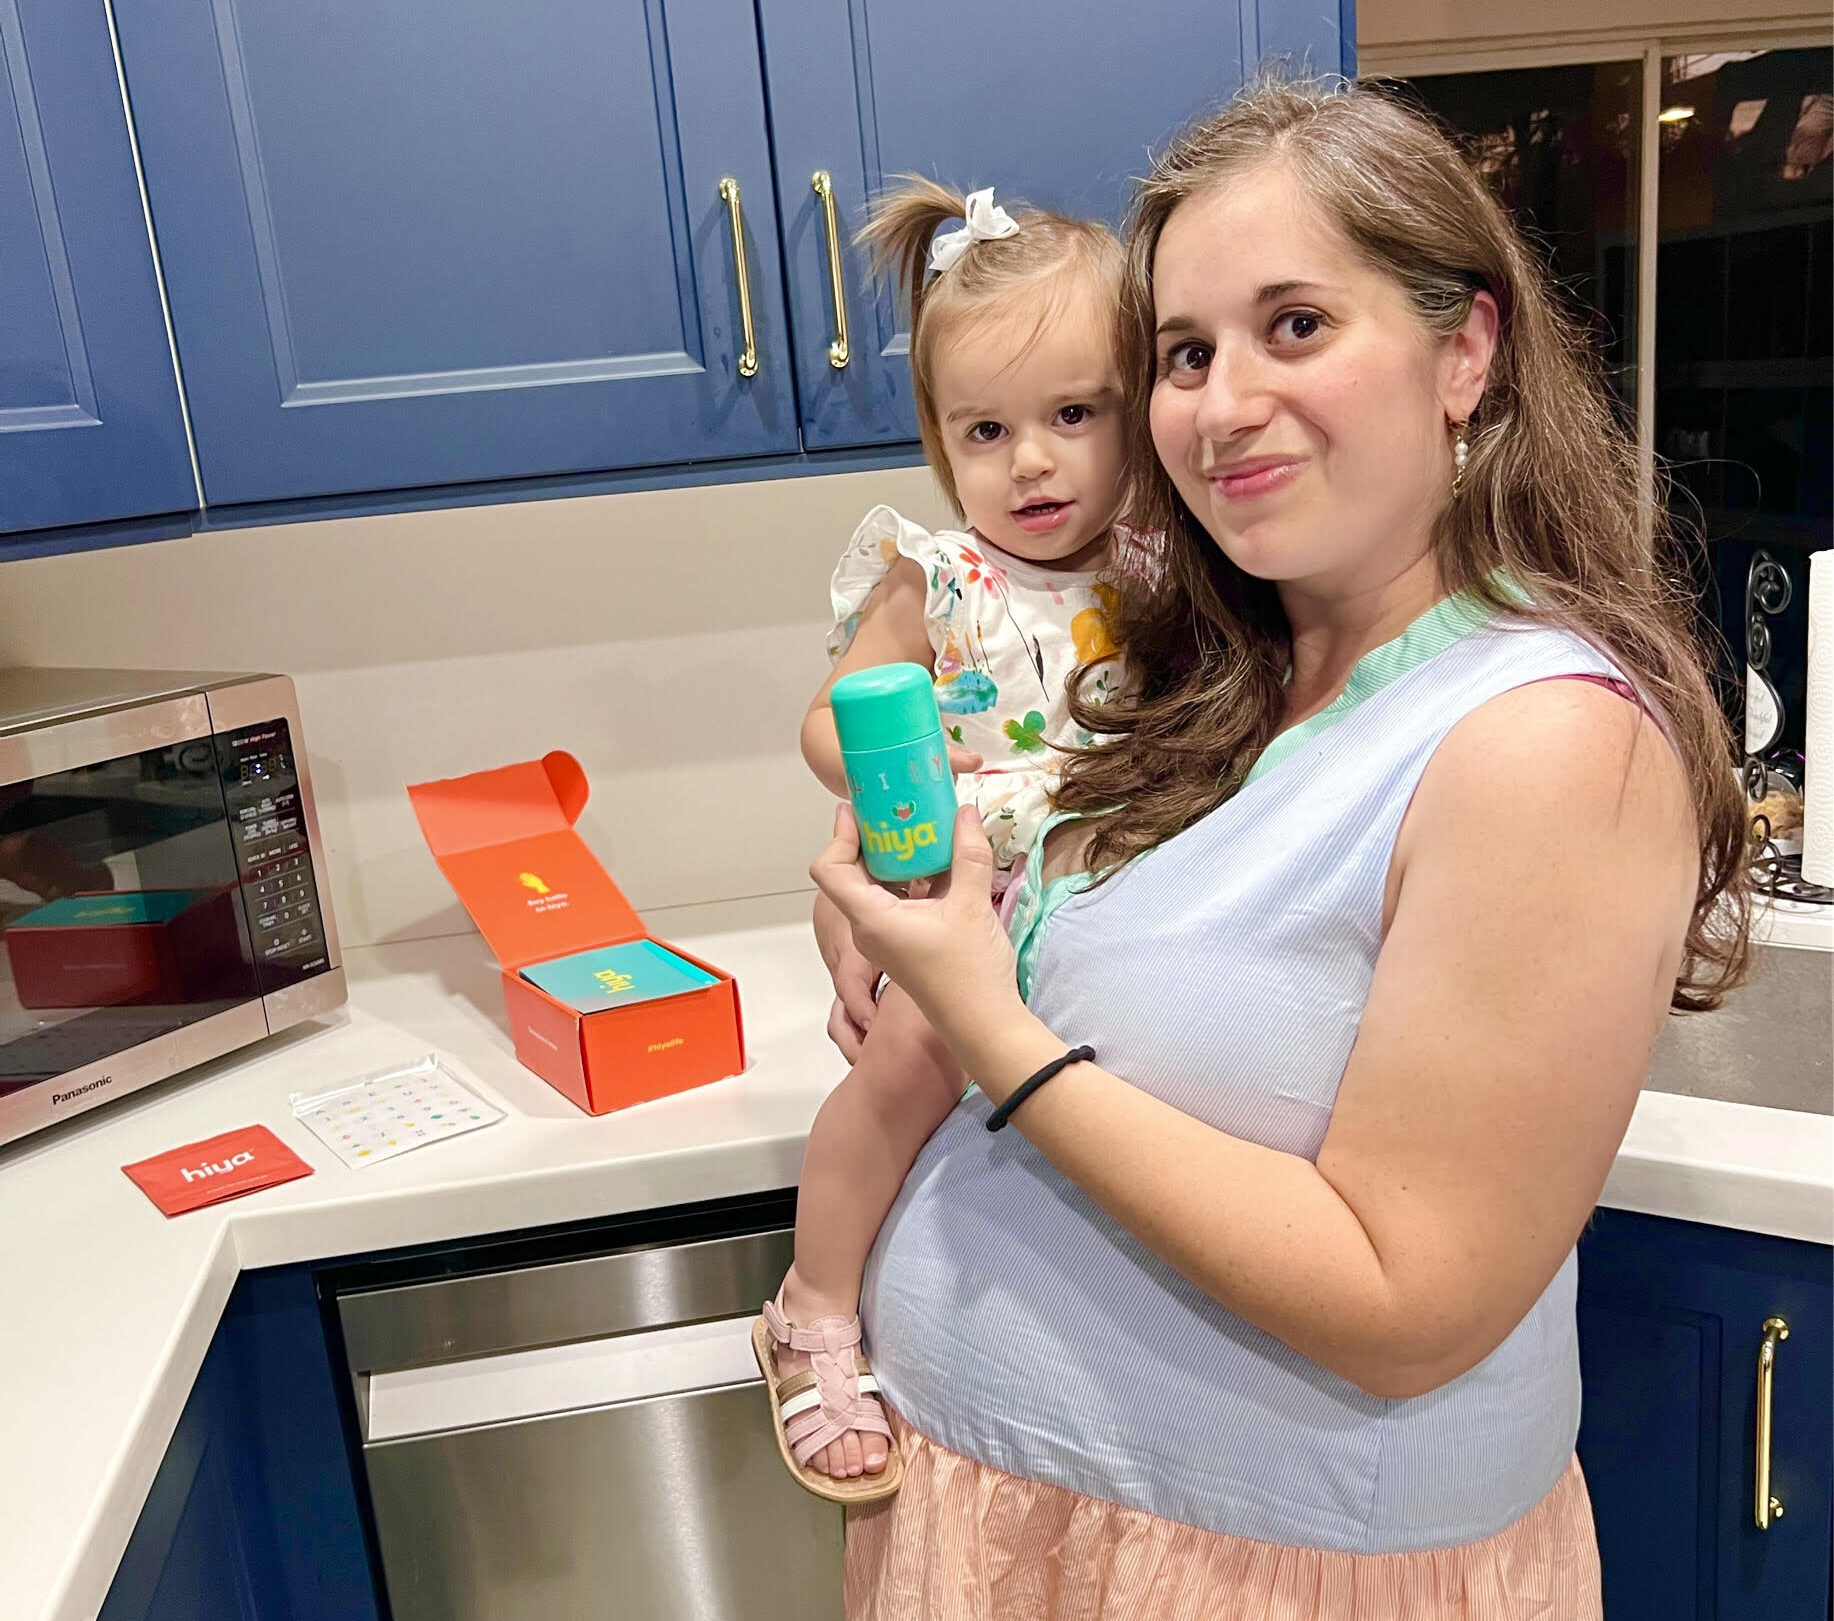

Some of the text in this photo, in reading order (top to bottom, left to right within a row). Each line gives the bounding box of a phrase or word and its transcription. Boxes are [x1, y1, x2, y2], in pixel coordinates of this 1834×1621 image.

[262, 731, 277, 740] Power
[863, 820, 938, 861] hiya
[52, 1075, 113, 1106] Panasonic
[180, 1151, 255, 1183] hiya
